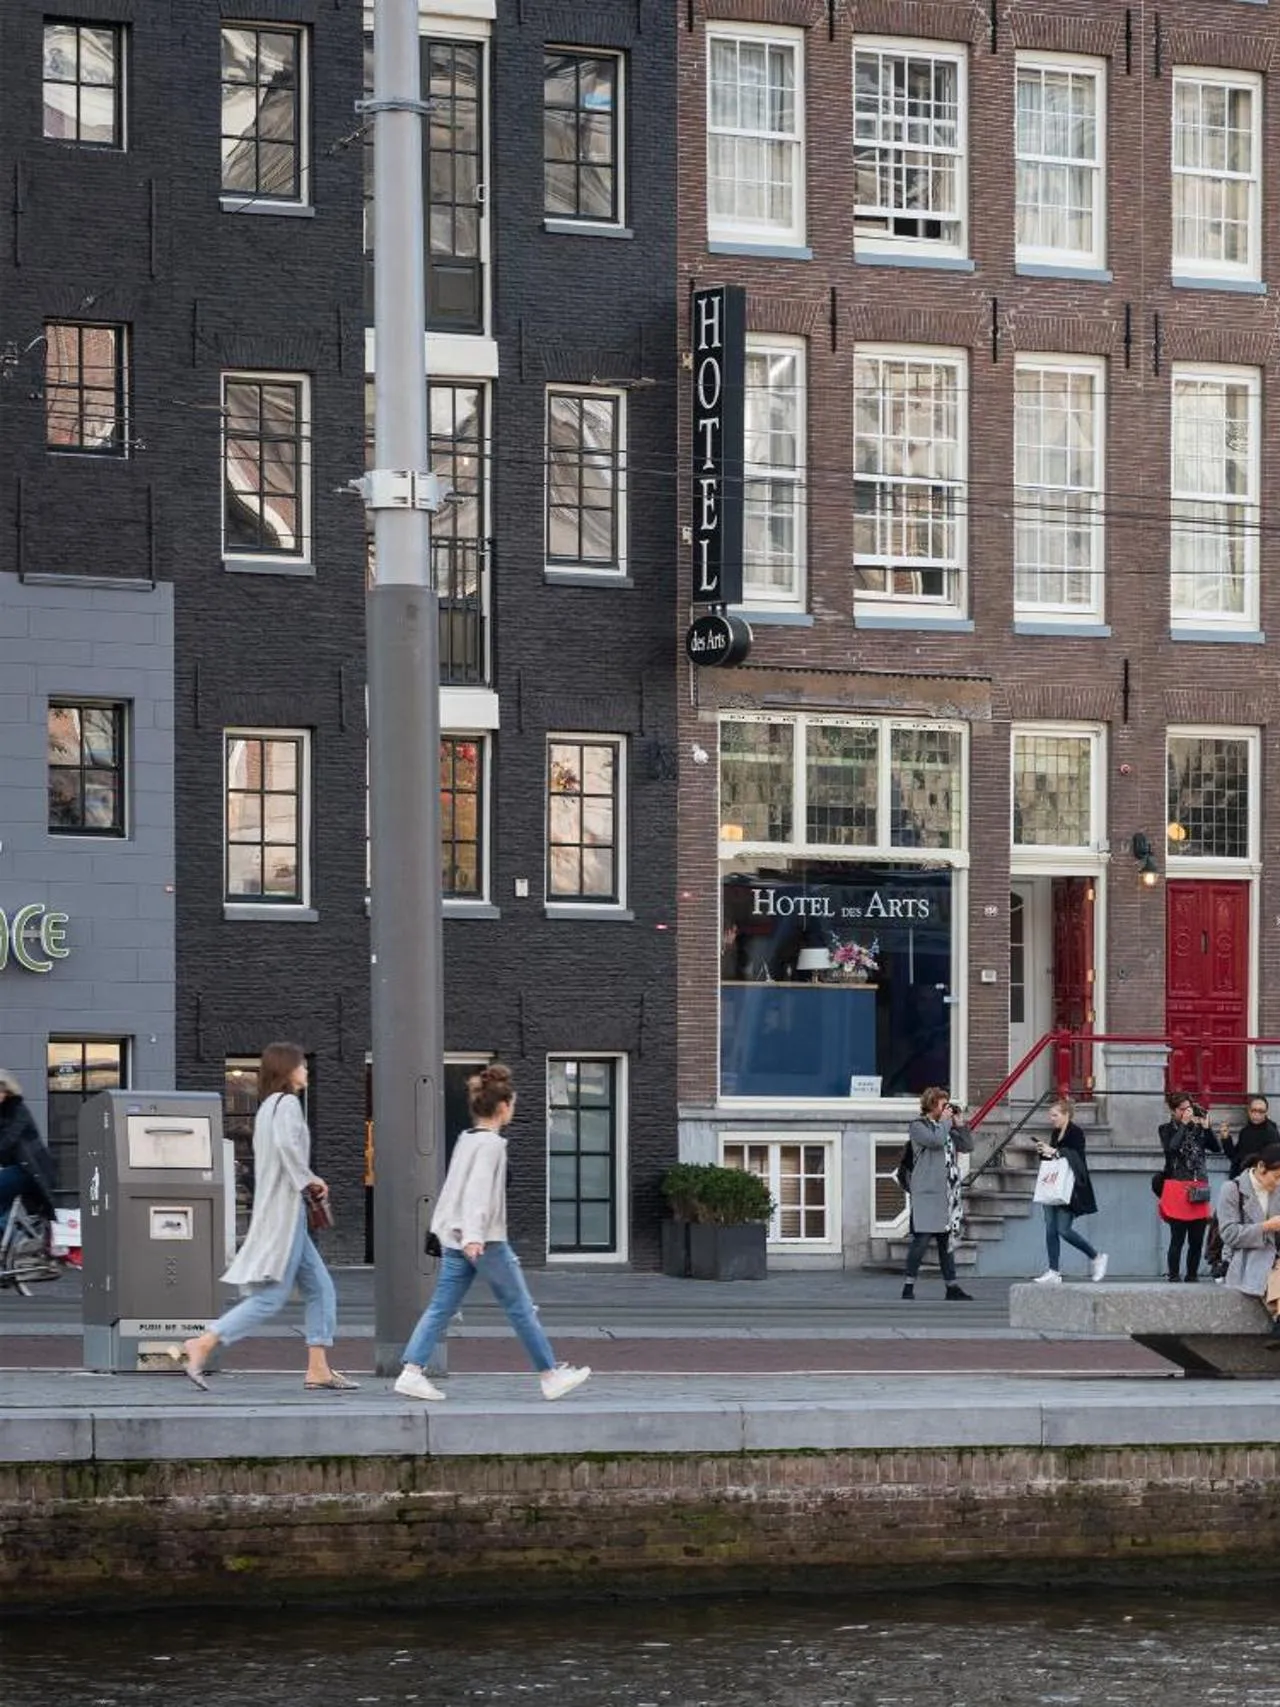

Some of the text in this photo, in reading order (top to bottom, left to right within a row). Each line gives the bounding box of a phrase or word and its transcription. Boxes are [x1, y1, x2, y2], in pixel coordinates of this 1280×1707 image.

[697, 296, 721, 592] HOTEL
[690, 629, 726, 651] des Arts
[752, 888, 836, 917] HOTEL
[864, 889, 931, 919] ARTS
[0, 902, 70, 973] CE
